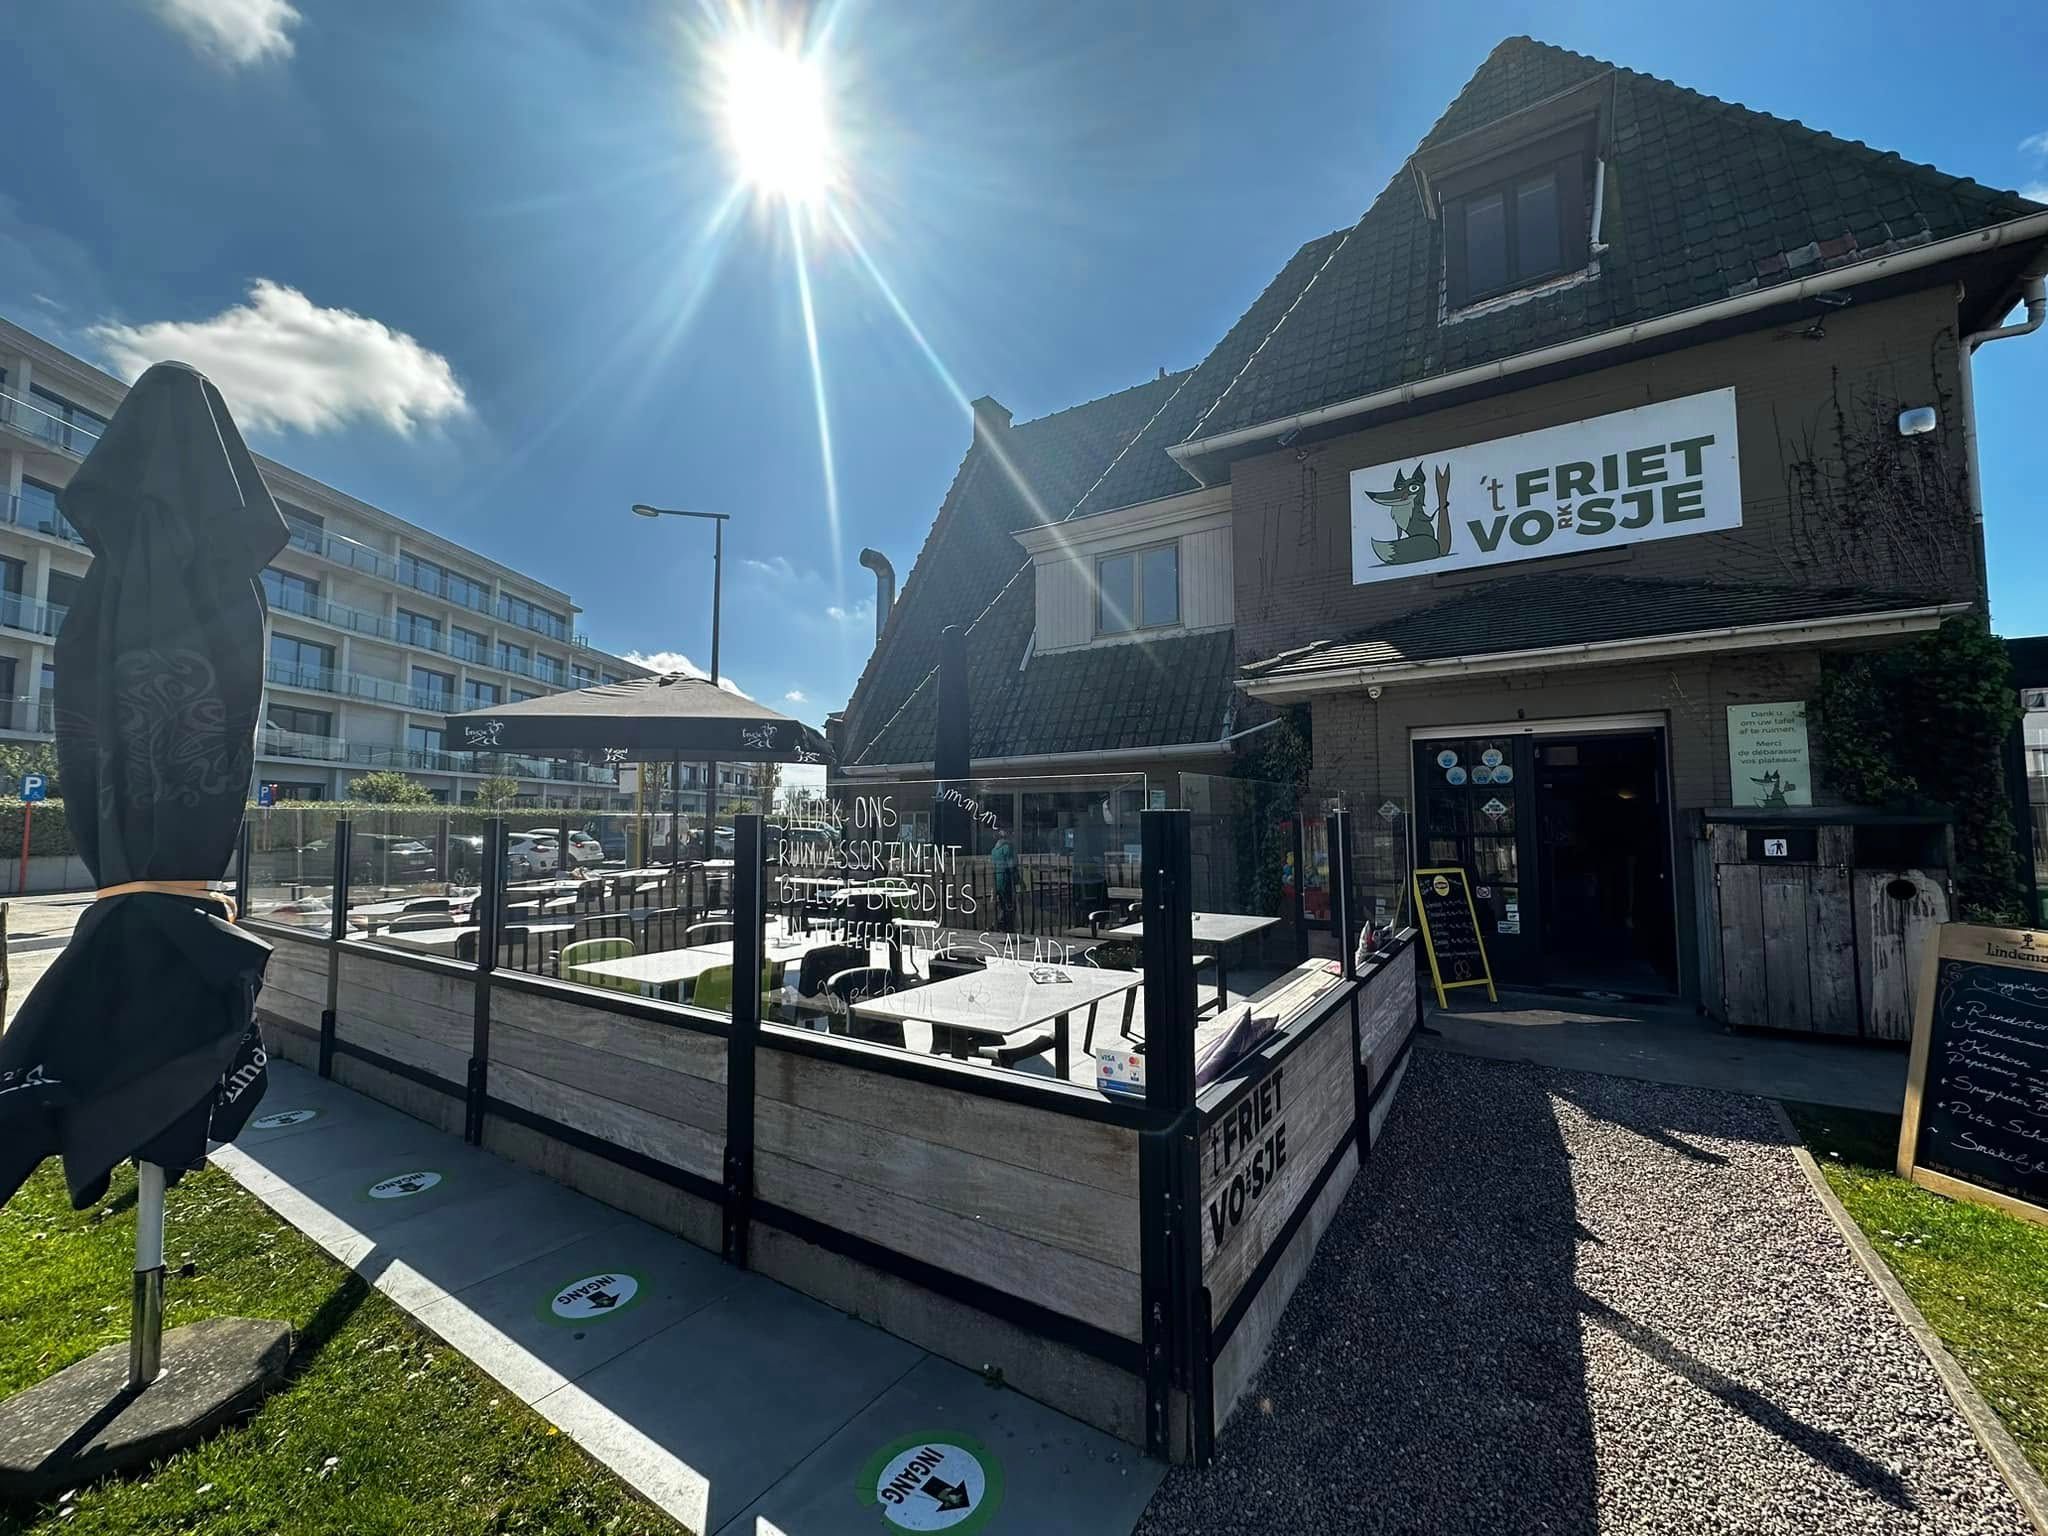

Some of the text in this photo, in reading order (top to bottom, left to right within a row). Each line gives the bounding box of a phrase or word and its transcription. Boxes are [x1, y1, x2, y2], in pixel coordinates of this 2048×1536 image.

[1515, 434, 1715, 507] FRIET
[1751, 709, 1774, 717] Dank
[1774, 717, 1794, 725] tafel
[24, 776, 42, 795] P
[261, 786, 269, 798] P
[855, 796, 898, 830] ONS
[779, 839, 962, 876] RUIM ASSORTIMENT
[976, 932, 1101, 970] SALADES
[1101, 1054, 1116, 1062] VISA
[1223, 1067, 1284, 1168] FRIET
[376, 1173, 425, 1191] INGANG
[557, 1275, 617, 1305] INGANG
[881, 1446, 945, 1504] INGANG
